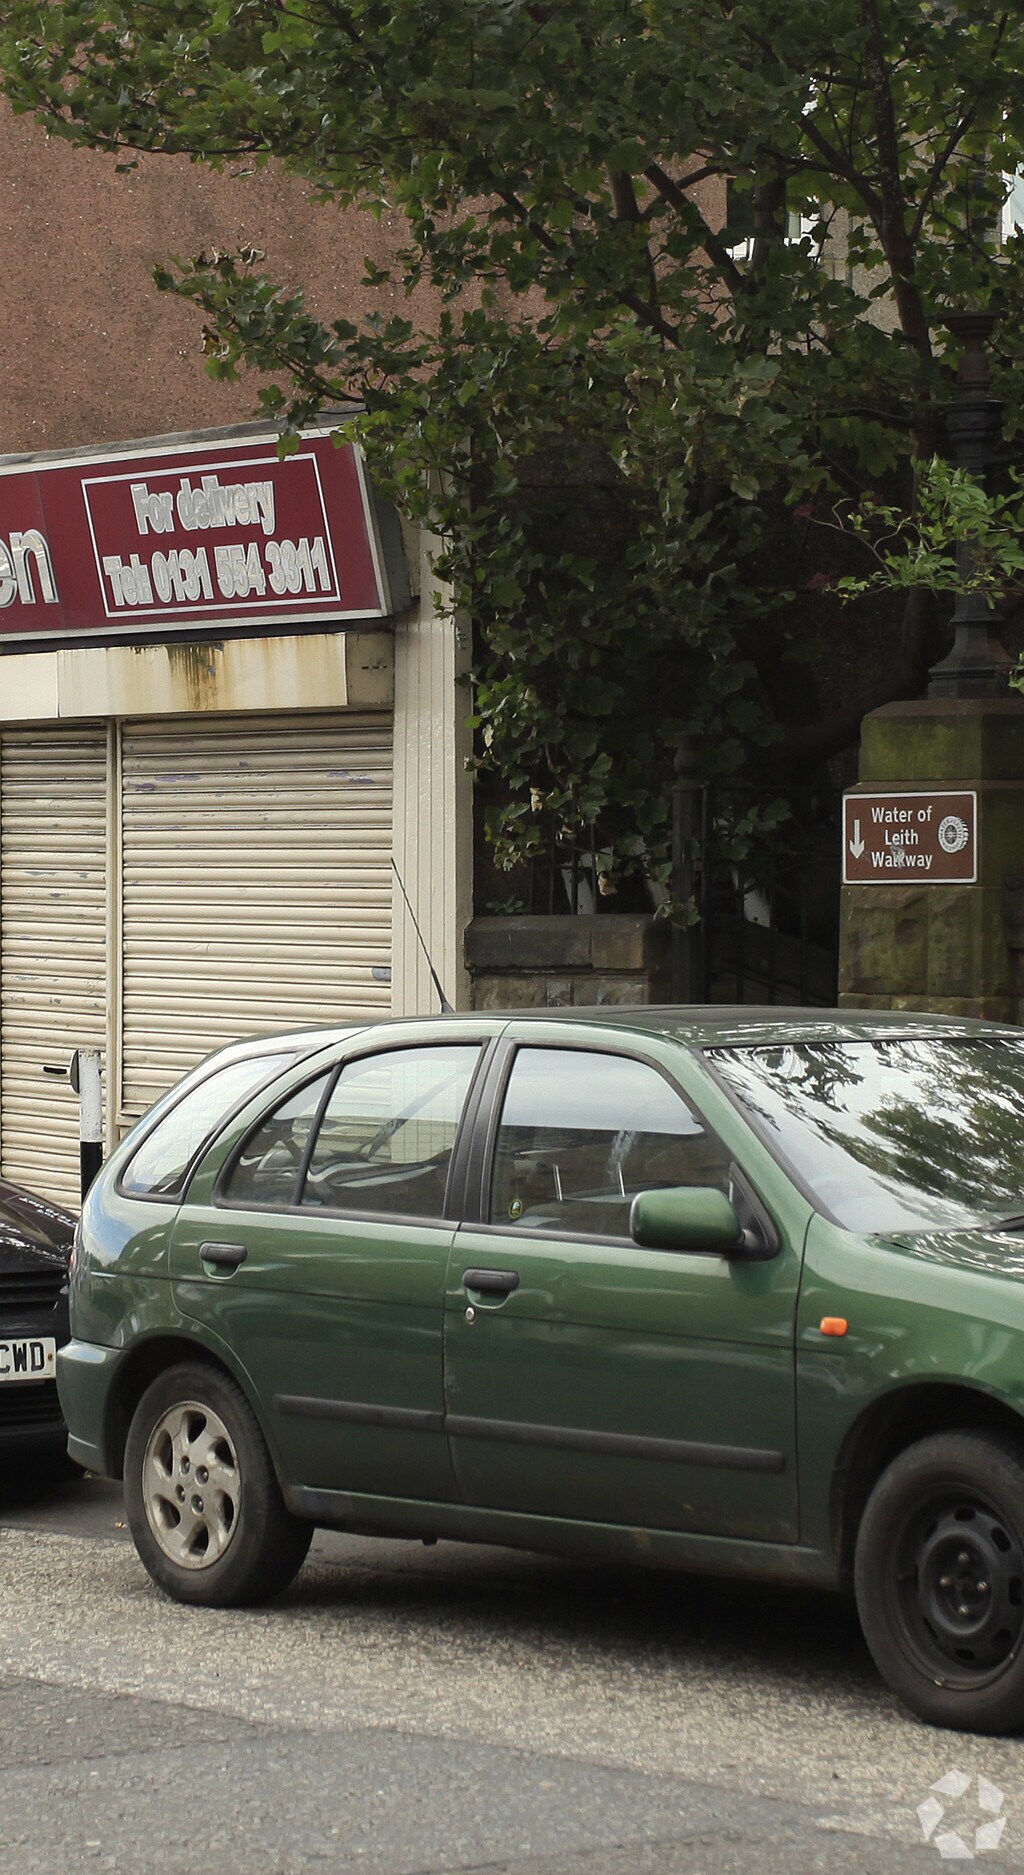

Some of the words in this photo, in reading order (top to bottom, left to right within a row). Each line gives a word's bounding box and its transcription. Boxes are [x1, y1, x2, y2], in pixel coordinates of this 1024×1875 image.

[130, 483, 175, 535] For
[176, 475, 275, 535] delivery
[151, 547, 214, 604] 0131
[214, 542, 265, 599] 554
[265, 536, 332, 595] 3311
[871, 807, 913, 823] Water
[917, 805, 933, 822] of
[884, 829, 919, 845] Leith
[871, 851, 933, 870] Walkway
